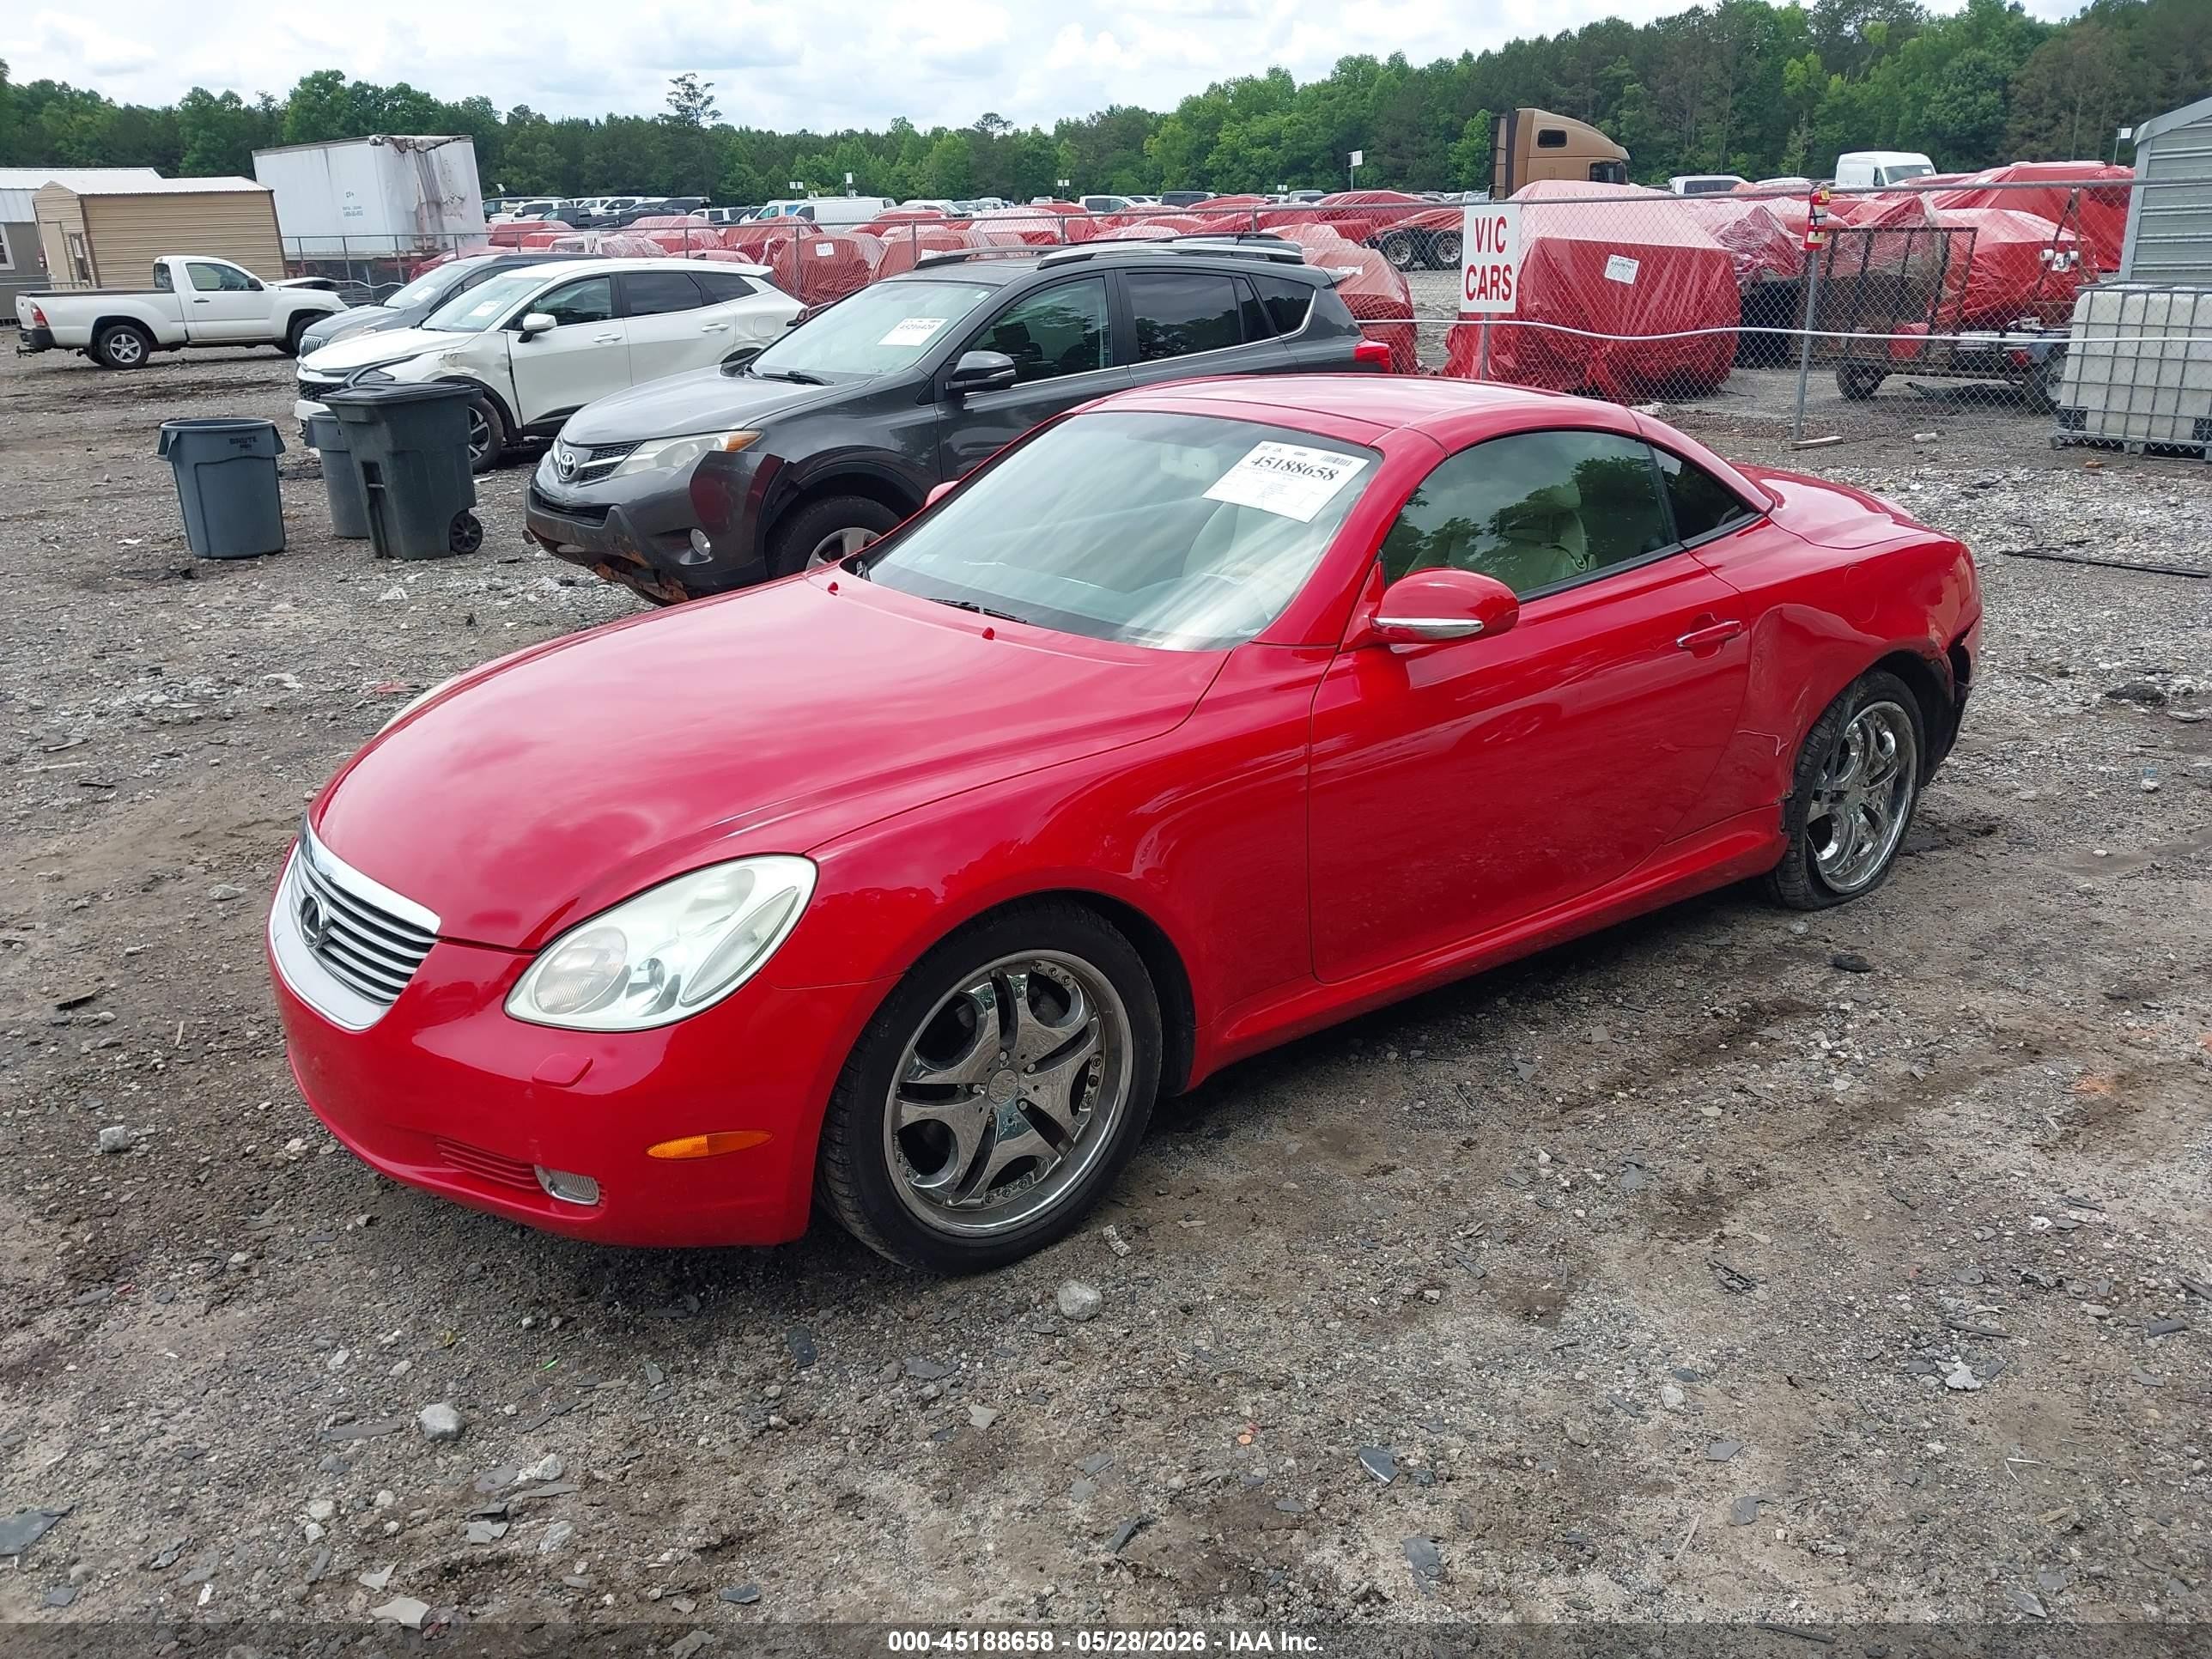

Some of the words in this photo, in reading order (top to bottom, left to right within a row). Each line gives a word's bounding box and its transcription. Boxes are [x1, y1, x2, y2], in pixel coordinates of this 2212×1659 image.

[1474, 216, 1508, 253] VIC
[1465, 264, 1513, 301] CARS
[1249, 455, 1340, 482] 45188658
